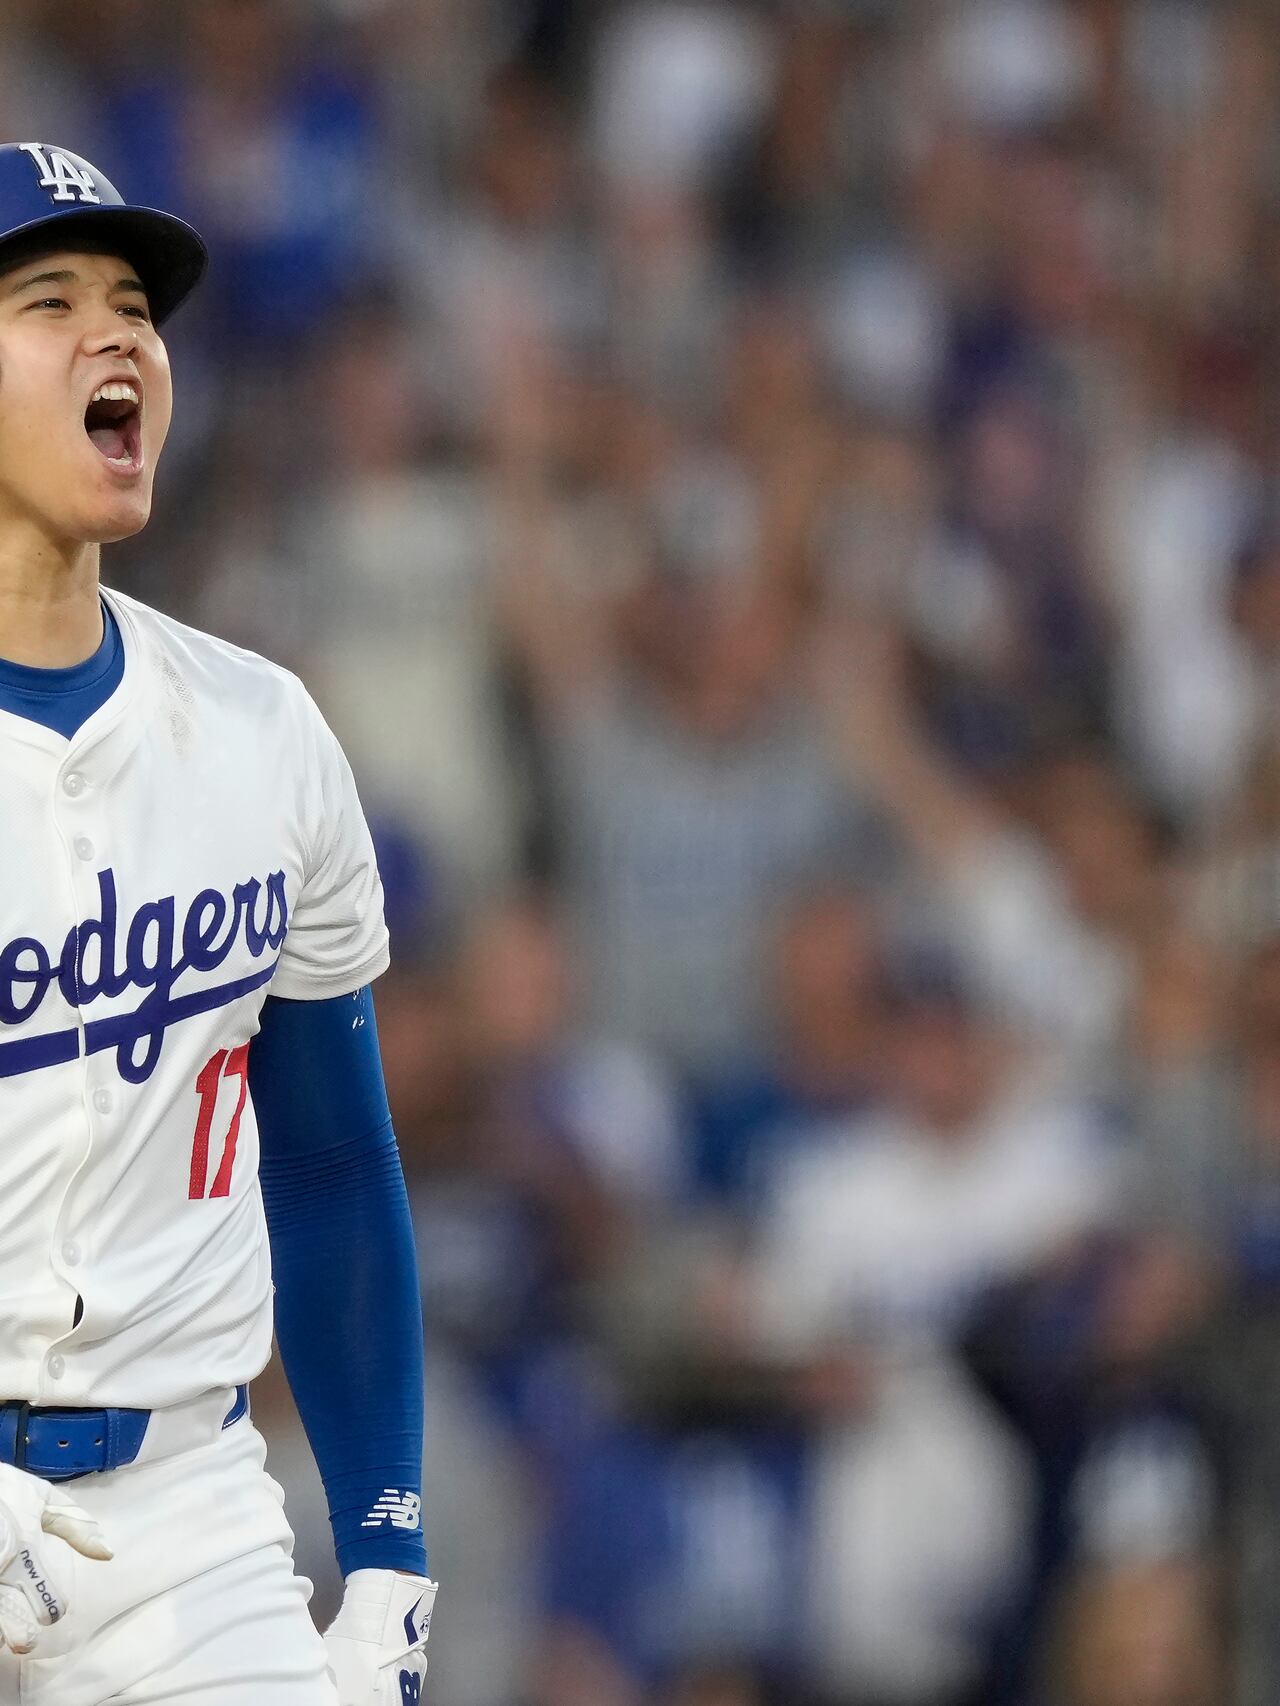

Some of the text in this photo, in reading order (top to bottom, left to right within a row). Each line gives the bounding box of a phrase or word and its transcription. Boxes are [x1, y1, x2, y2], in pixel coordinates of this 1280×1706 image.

[19, 142, 101, 204] LA
[188, 1040, 250, 1200] 17
[20, 1549, 40, 1579] new
